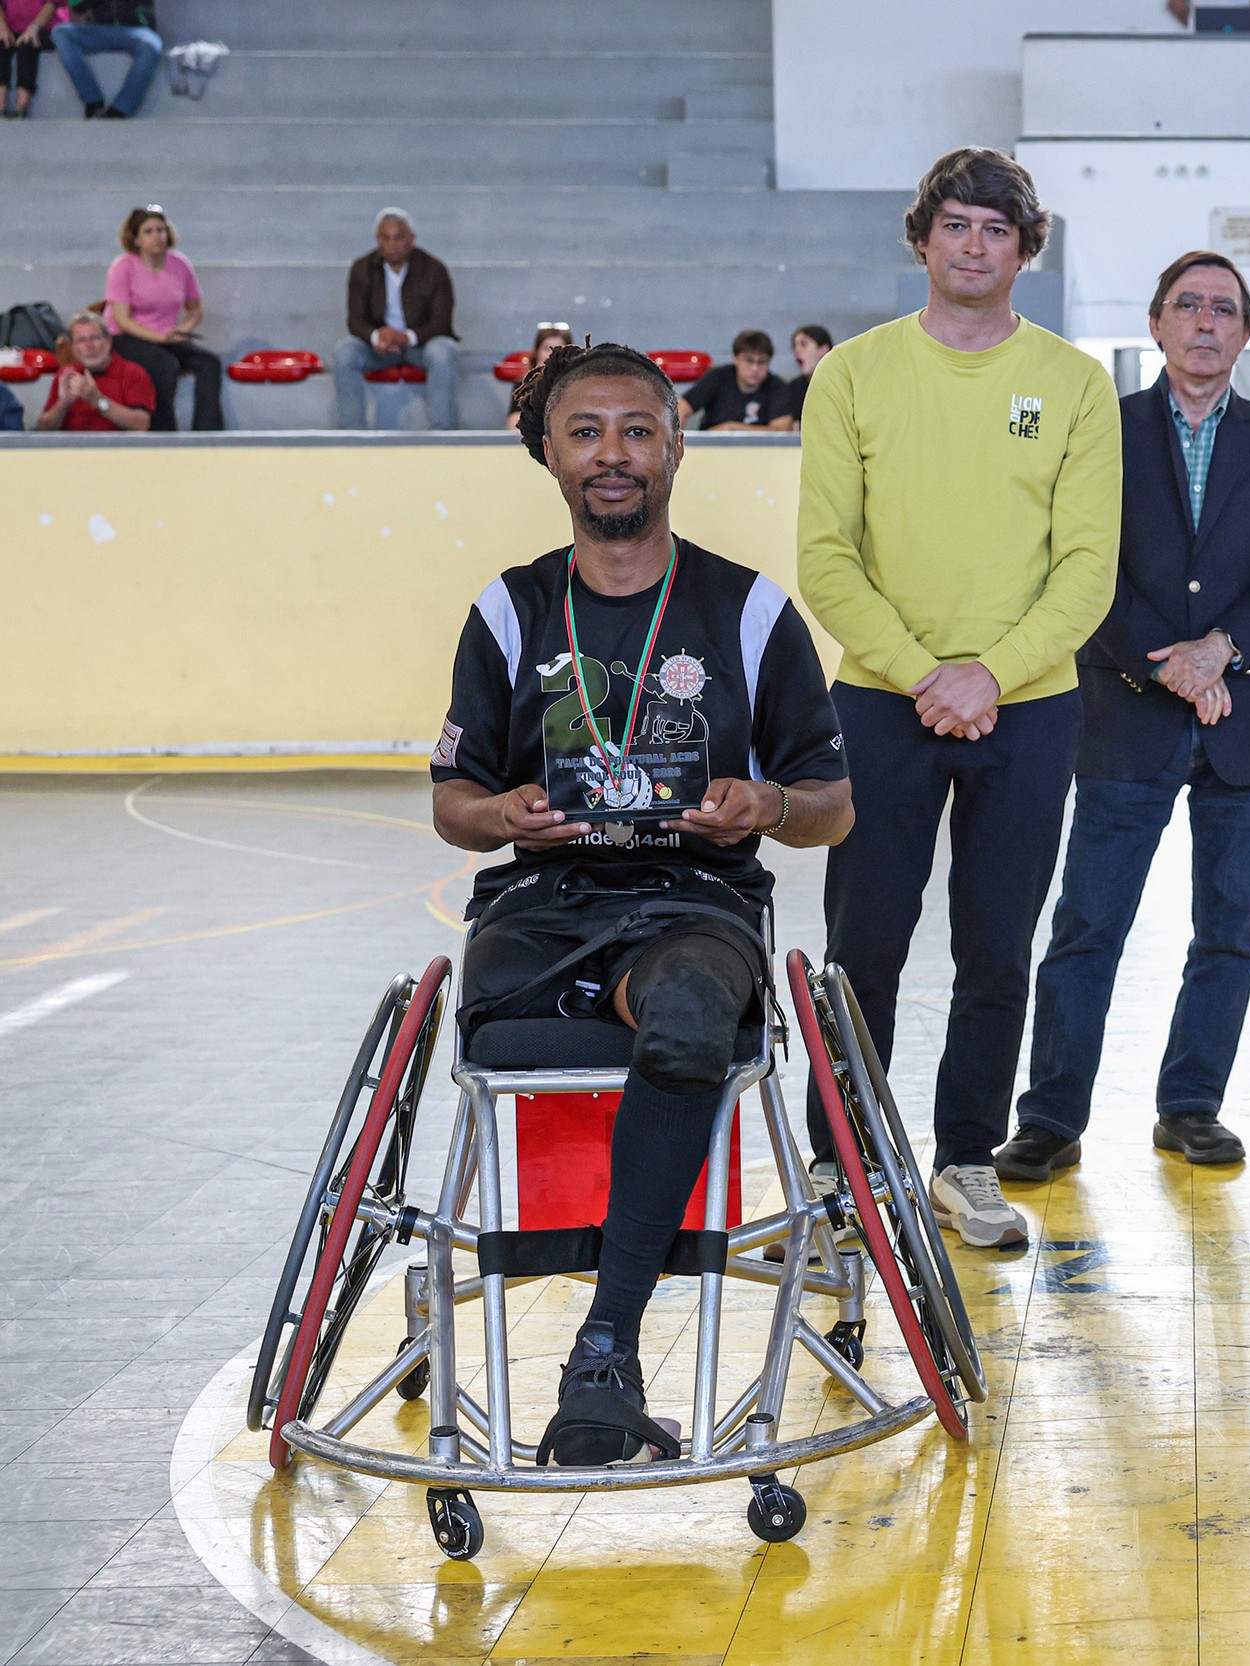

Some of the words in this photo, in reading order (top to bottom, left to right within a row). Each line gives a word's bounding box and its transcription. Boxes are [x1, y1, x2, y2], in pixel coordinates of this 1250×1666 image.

[1011, 393, 1042, 411] LION
[681, 656, 703, 672] NAVAL
[556, 757, 585, 770] TAÇA
[608, 754, 666, 767] PORTUGAL
[576, 771, 609, 782] FINAL
[614, 769, 643, 780] FOUR
[652, 767, 682, 779] 2026
[567, 831, 681, 850] ndeol4all
